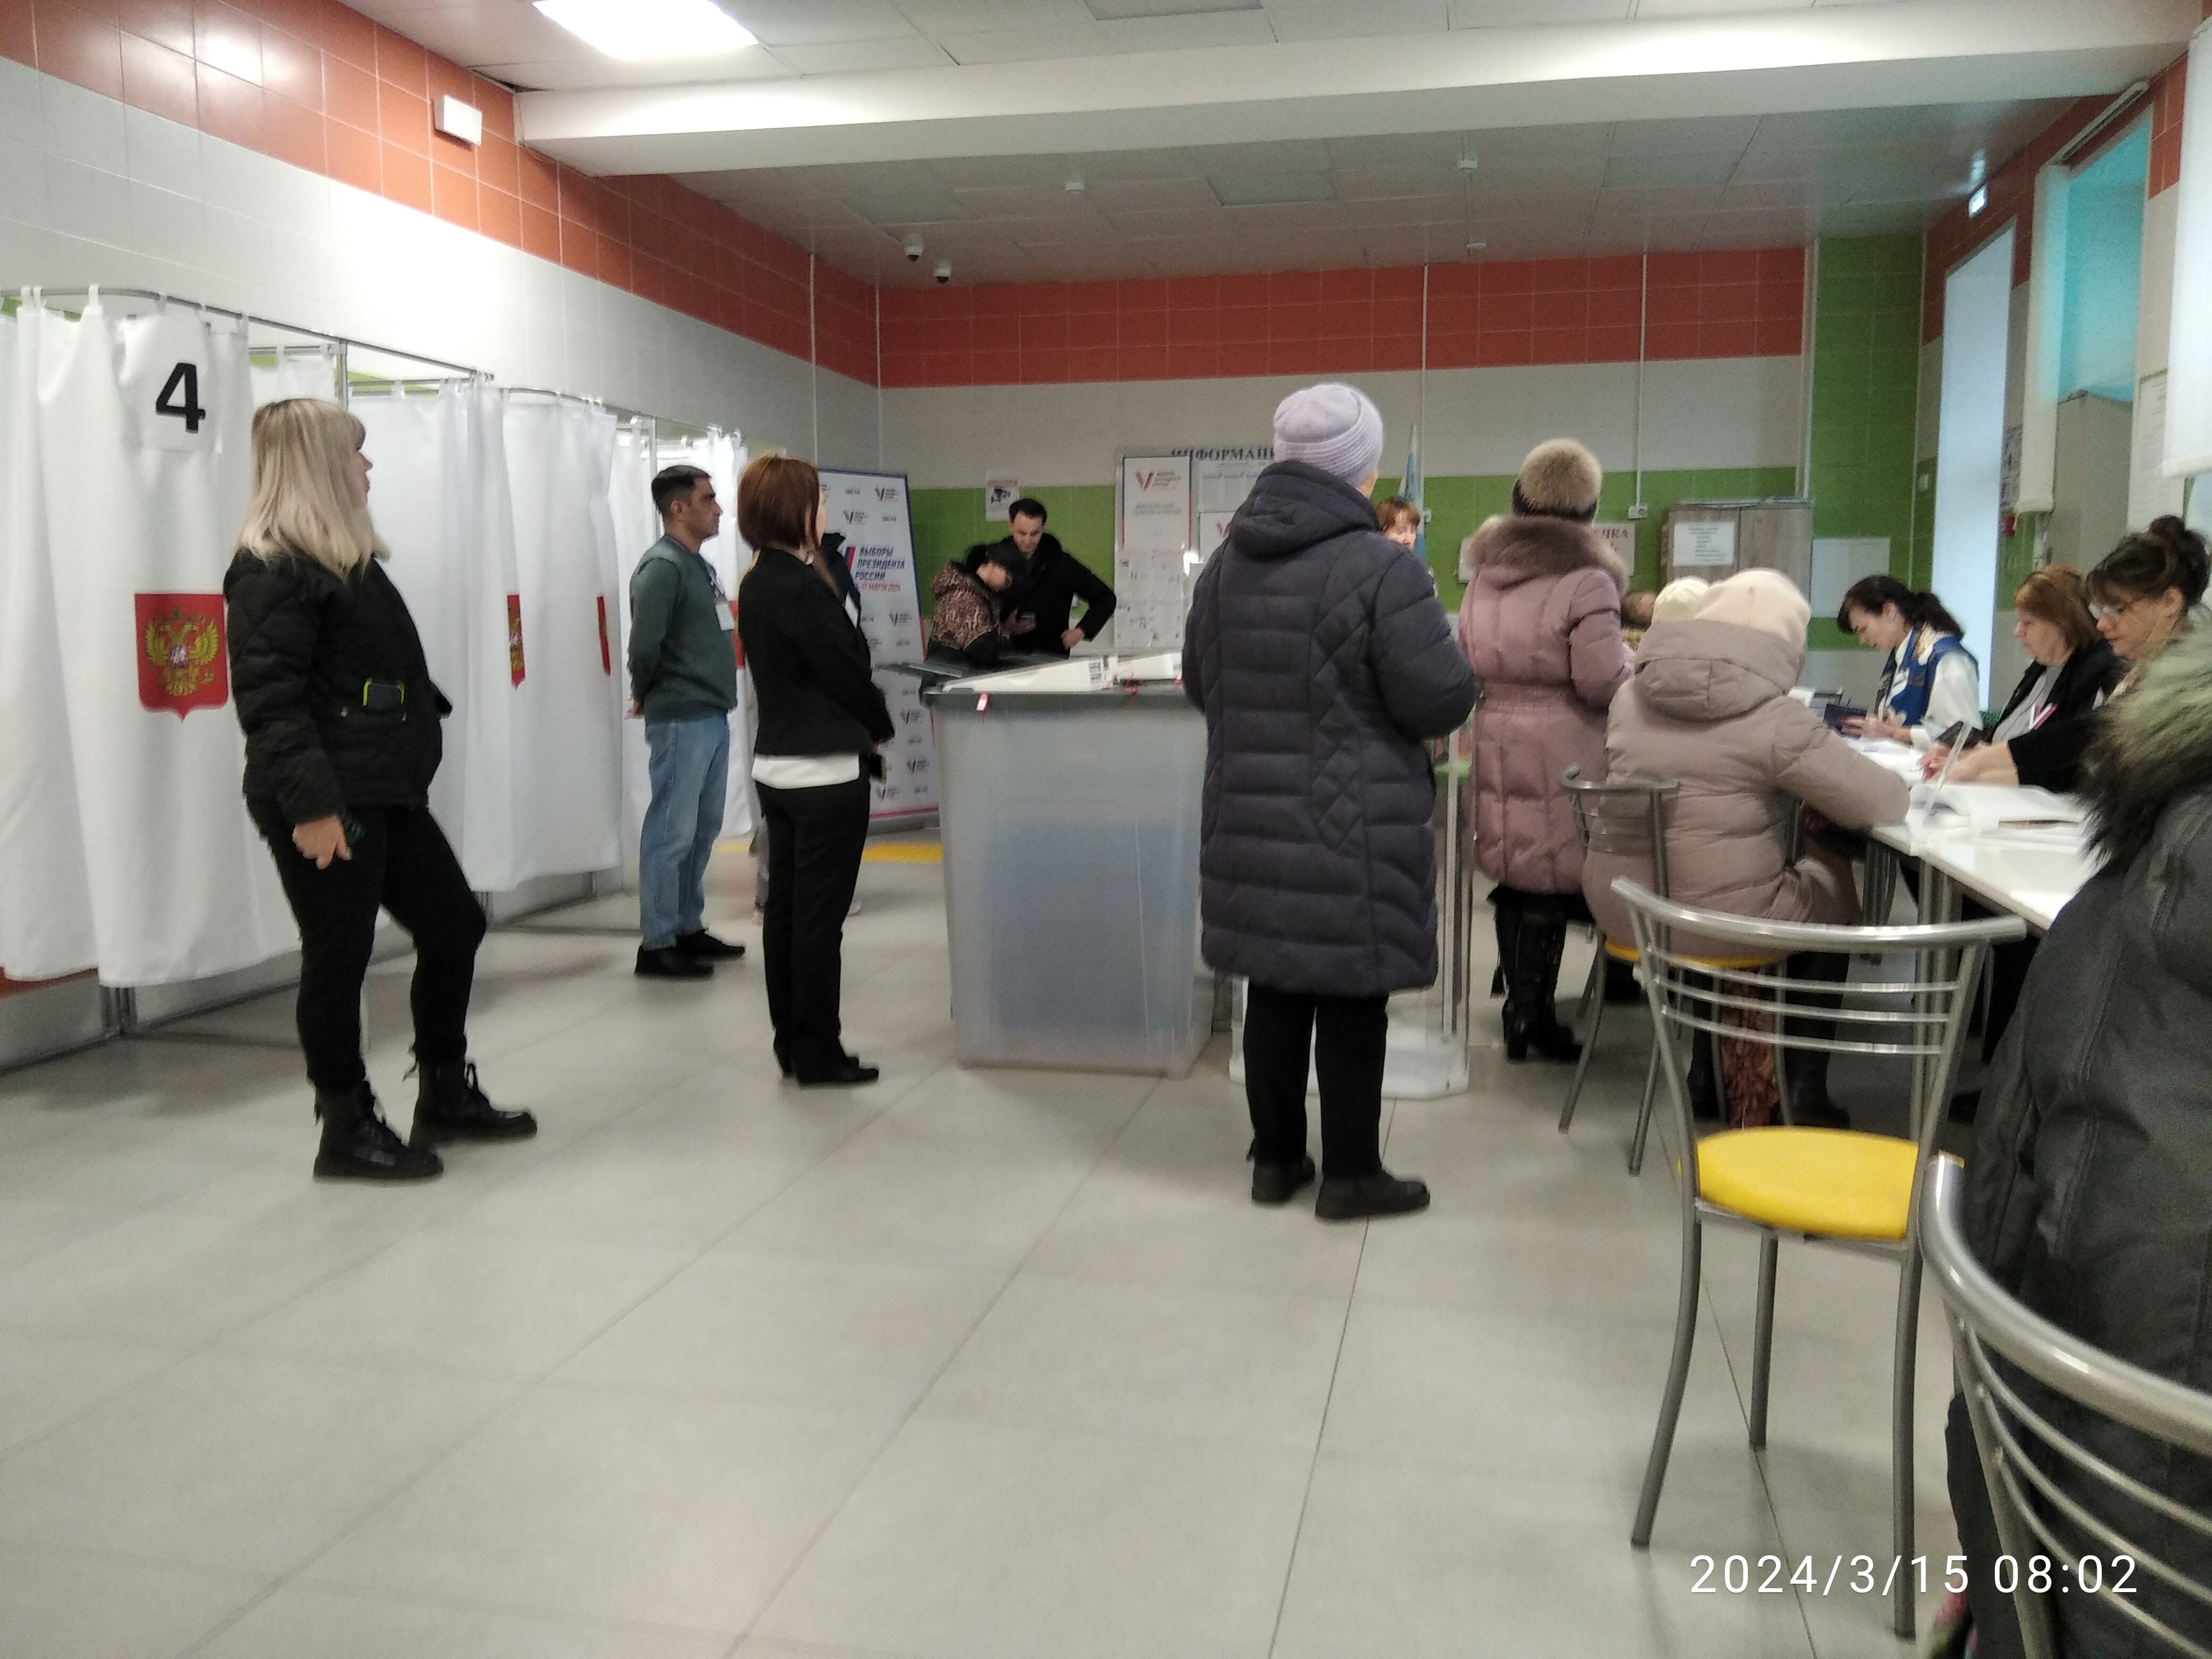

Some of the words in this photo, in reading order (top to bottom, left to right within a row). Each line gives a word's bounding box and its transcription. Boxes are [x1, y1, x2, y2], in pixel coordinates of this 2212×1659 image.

[156, 362, 206, 433] 4
[859, 546, 894, 557] ВЫБОРЫ
[857, 558, 905, 570] ПРЕЗИДЕНТА
[855, 571, 886, 581] РОССИИ
